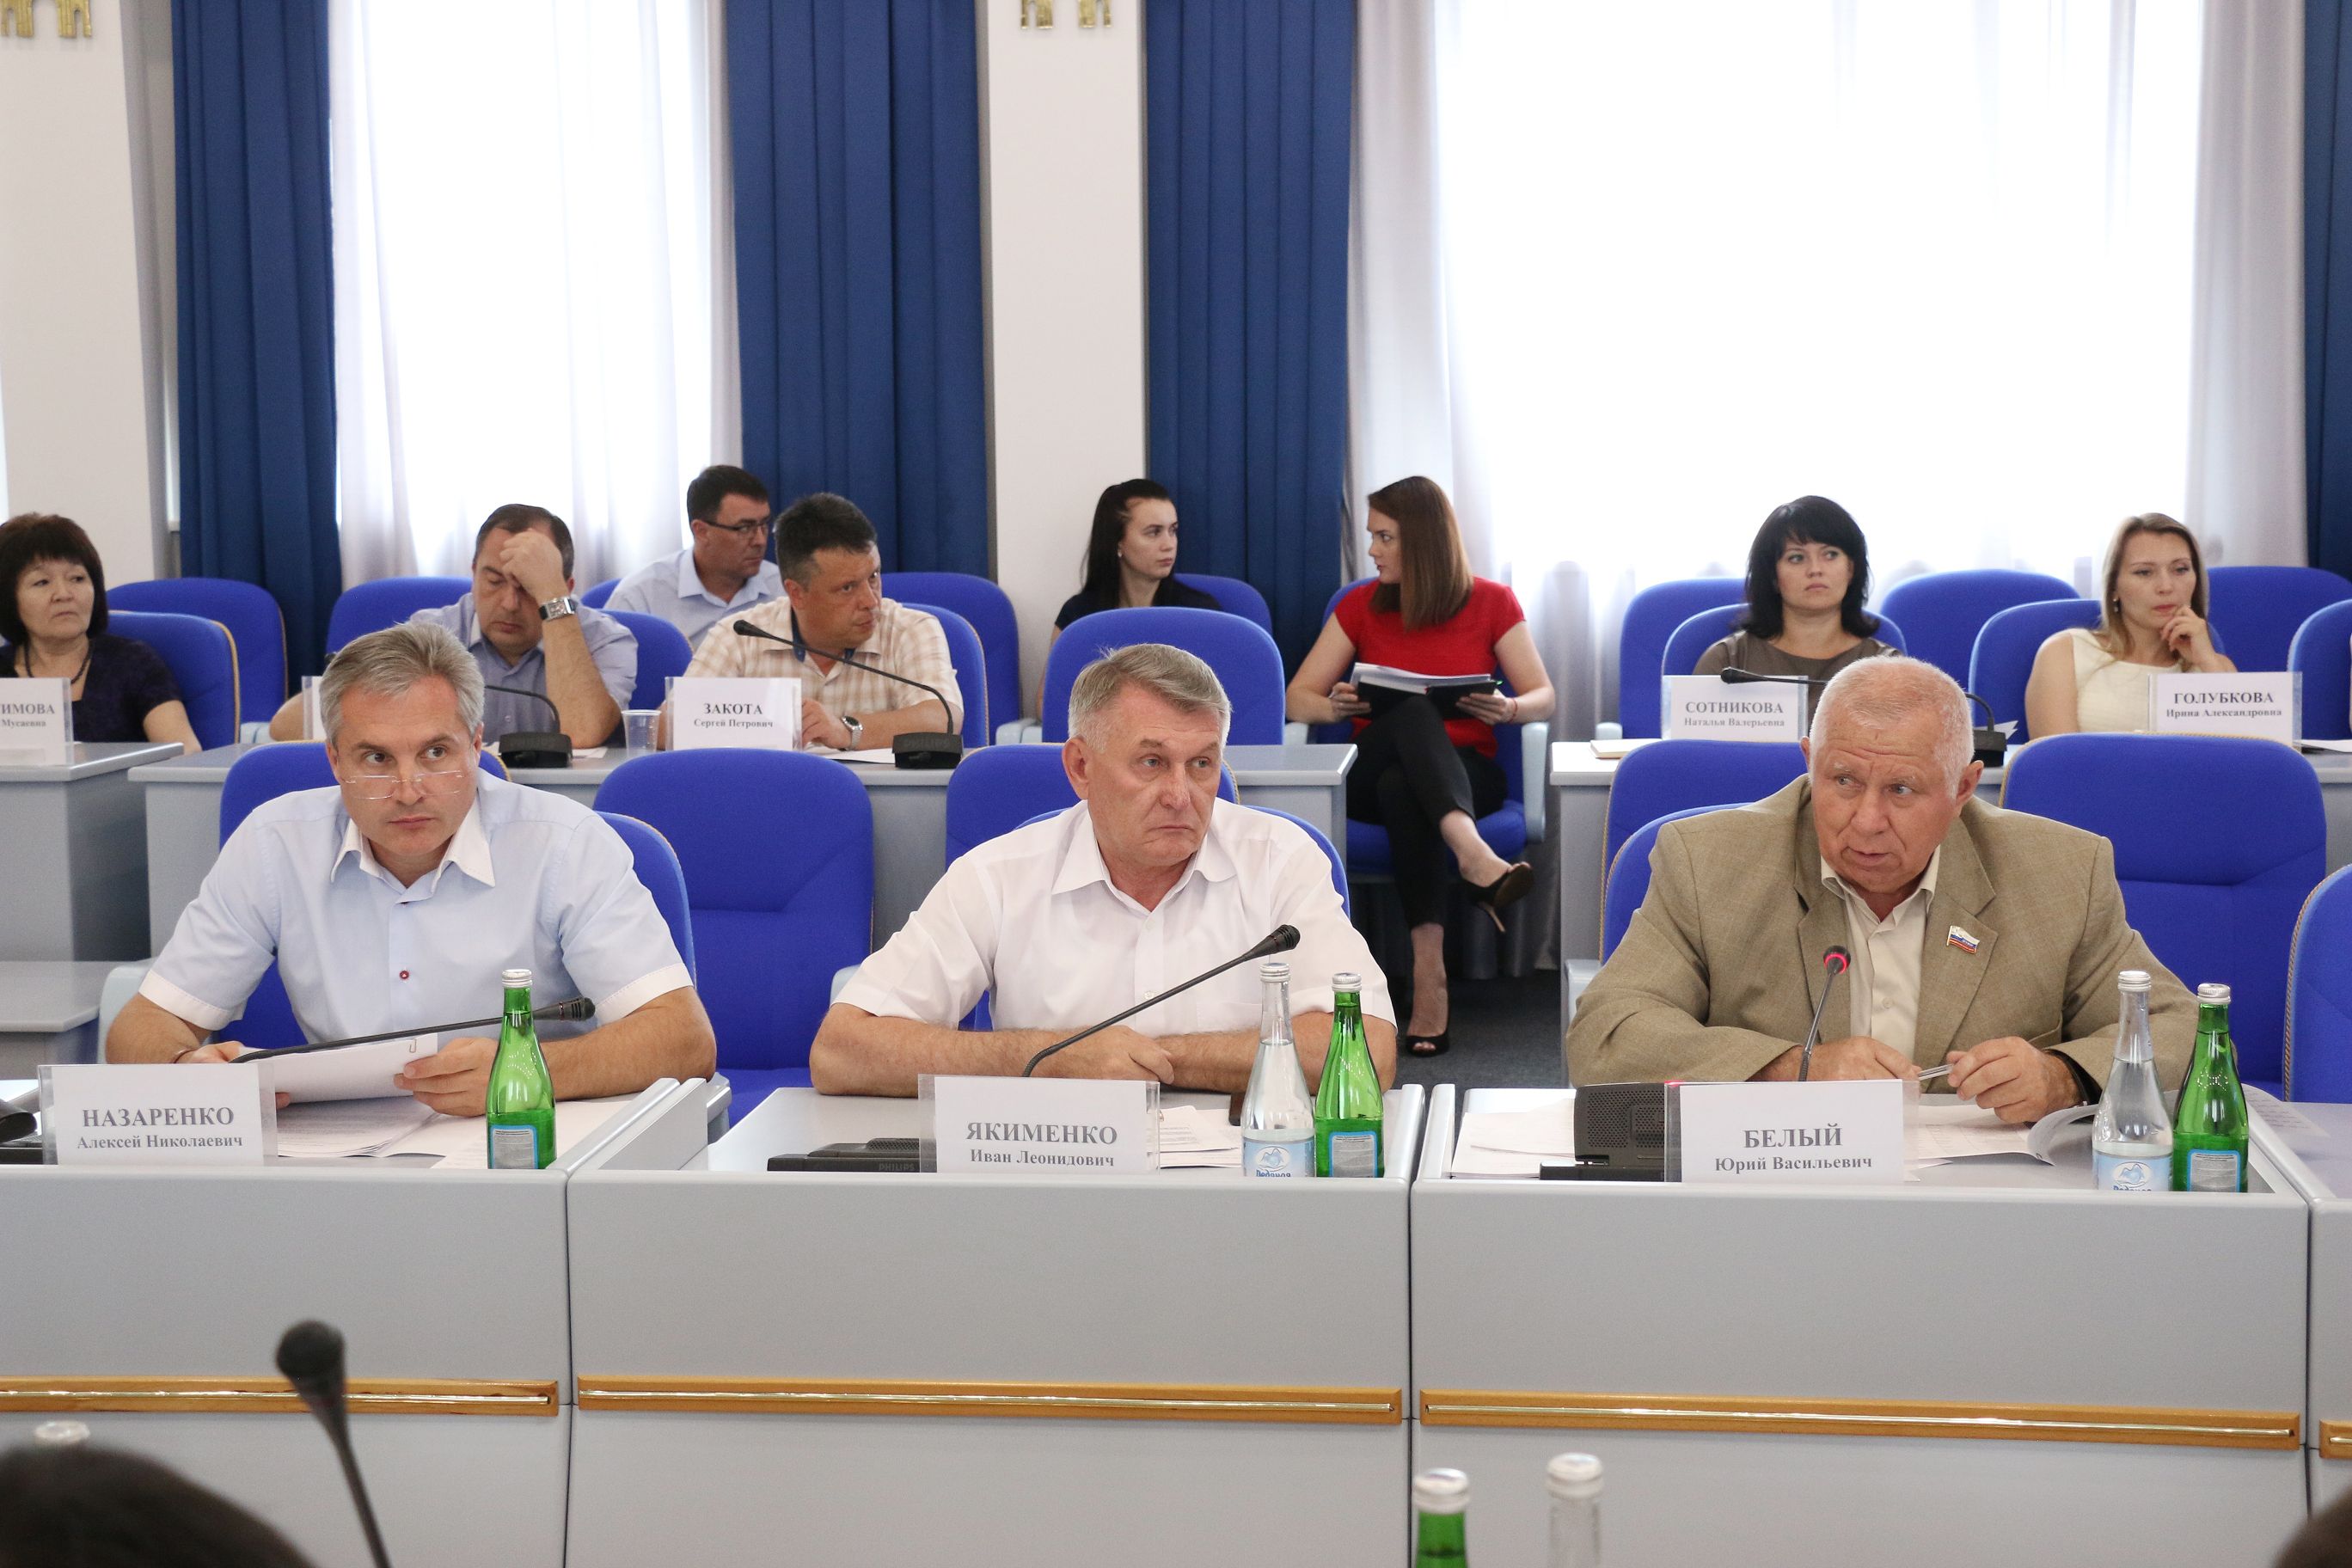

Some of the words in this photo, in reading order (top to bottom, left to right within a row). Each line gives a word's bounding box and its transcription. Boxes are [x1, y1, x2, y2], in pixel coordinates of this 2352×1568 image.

[2174, 692, 2274, 704] ГОЛУБКОВА
[1, 703, 55, 714] ИМОВА
[704, 703, 763, 714] ЗАКОТА
[1686, 701, 1783, 714] СОТНИКОВА
[2166, 709, 2199, 718] Ирина
[2203, 708, 2282, 718] Александровна
[694, 719, 726, 729] Сергей
[729, 719, 773, 729] Петрович
[1684, 718, 1725, 726] Наталья
[1728, 718, 1785, 728] Валерьевна
[83, 1106, 235, 1128] НАЗАРЕНКО
[966, 1122, 1118, 1145] ЯКИМЕНКО
[1743, 1123, 1842, 1148] БЕЛЫЙ
[77, 1135, 142, 1148] Алексей
[146, 1134, 243, 1148] Николаевич
[971, 1148, 1012, 1163] Иван
[1016, 1150, 1115, 1167] Леонидович
[1715, 1156, 1767, 1174] Юрий
[1773, 1155, 1872, 1171] Васильевич
